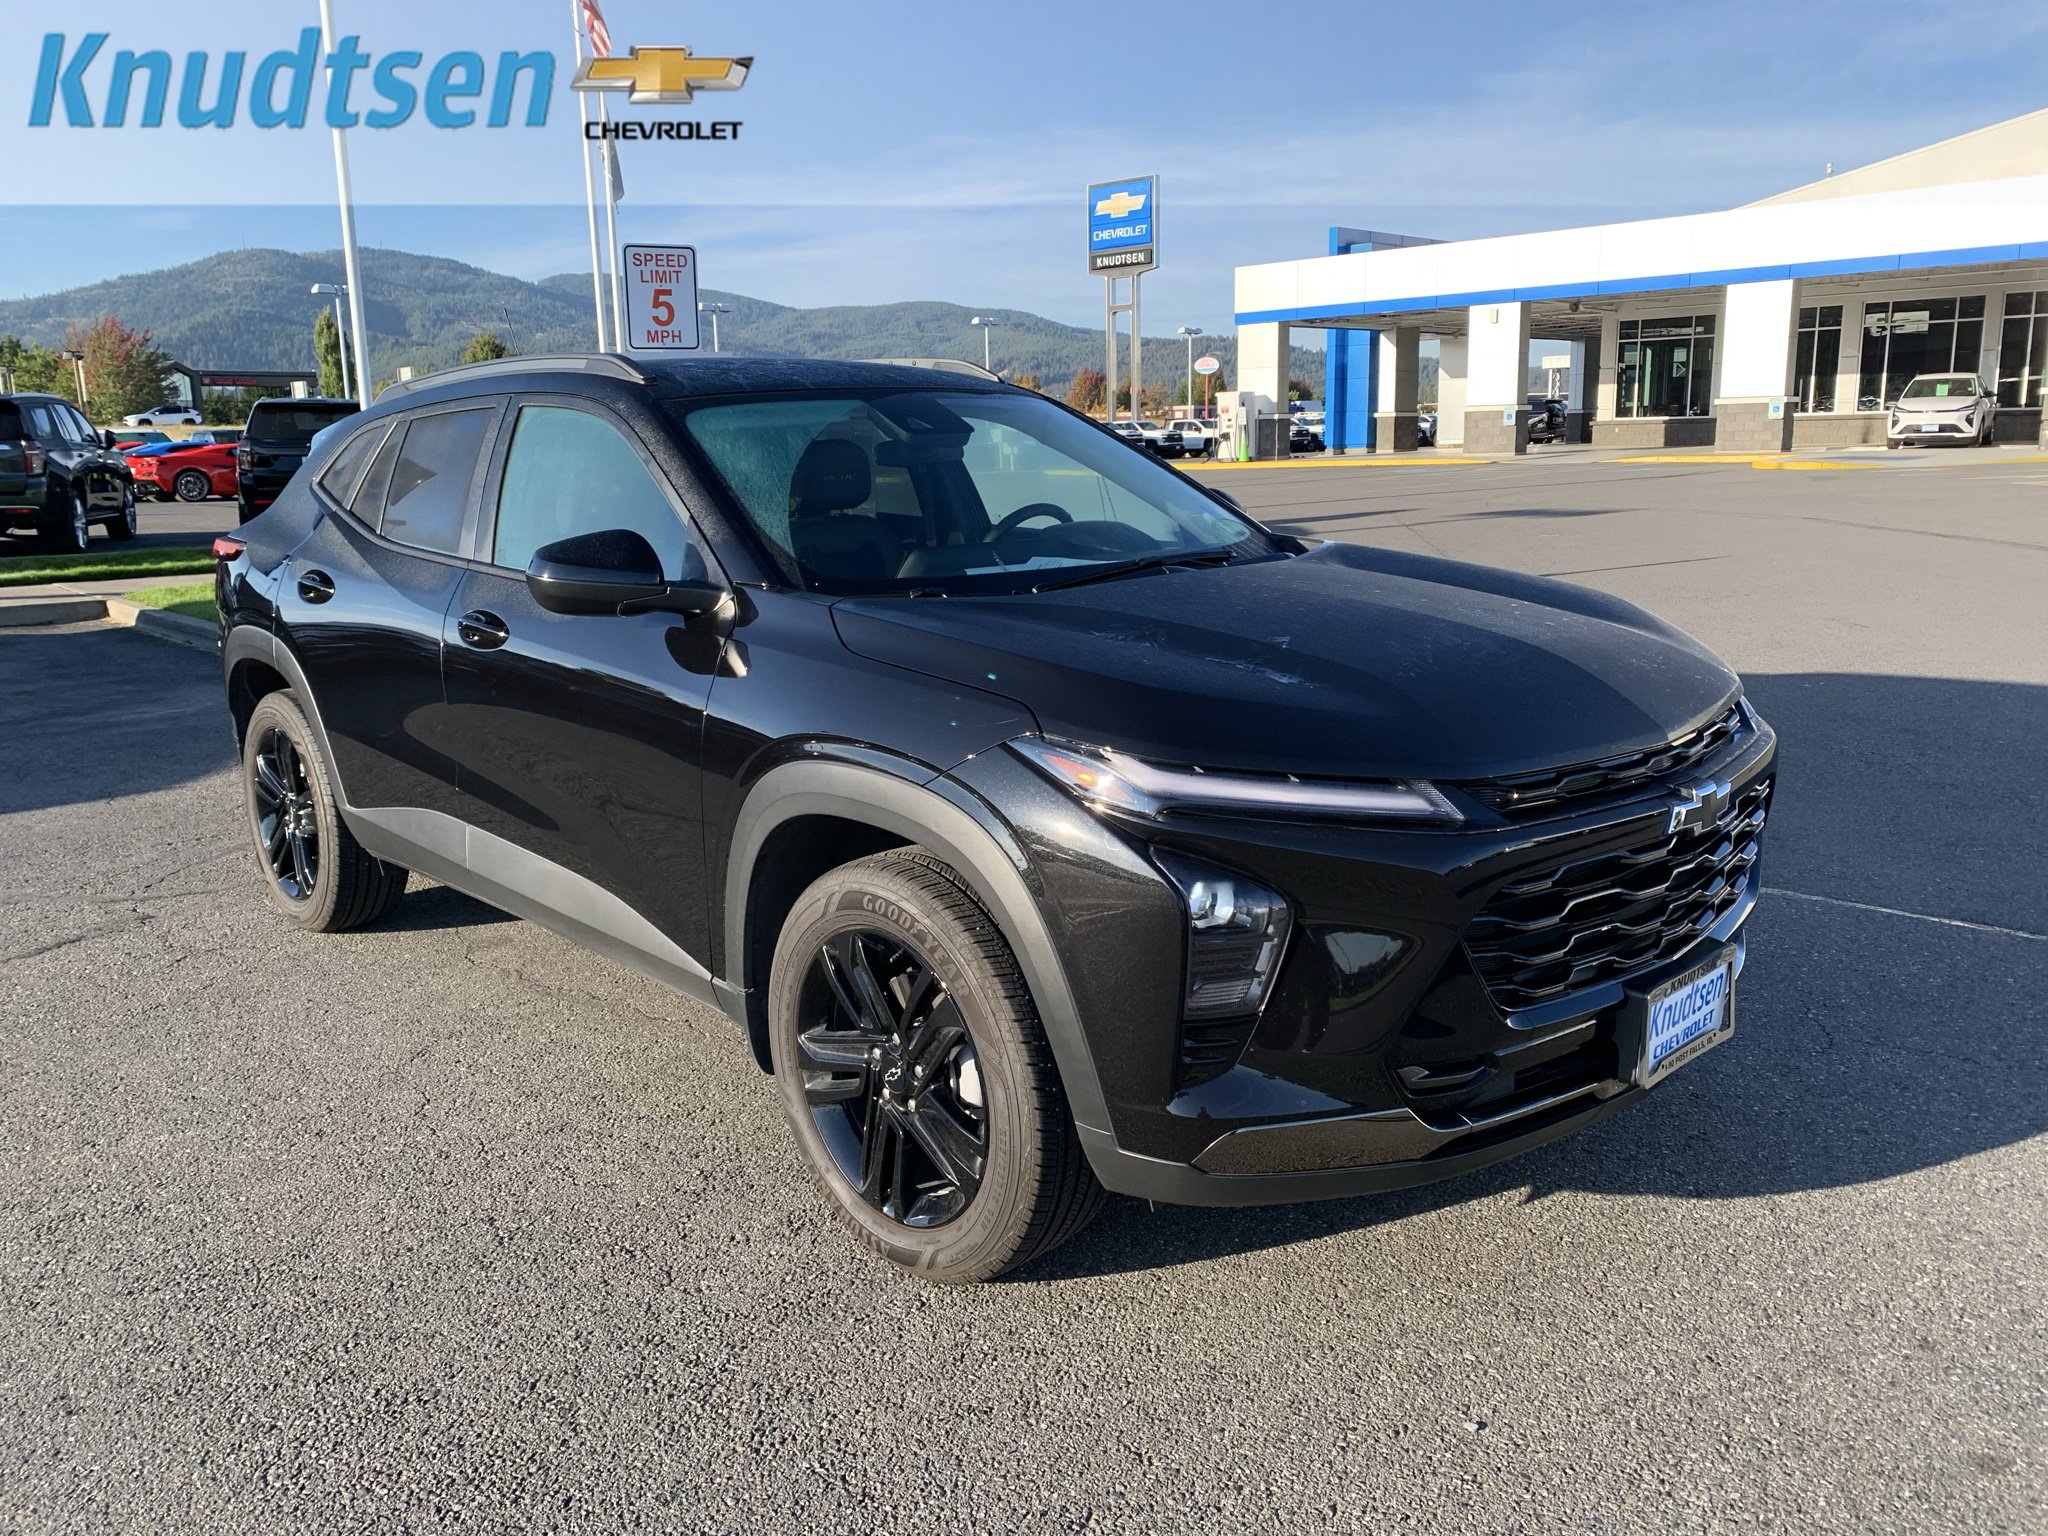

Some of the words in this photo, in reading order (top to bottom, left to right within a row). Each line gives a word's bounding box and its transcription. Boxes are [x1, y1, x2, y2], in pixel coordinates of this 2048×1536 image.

[1093, 224, 1147, 241] CHEVROLET
[632, 252, 688, 268] SPEED
[1096, 252, 1145, 267] KNUDTSEN
[640, 270, 682, 284] LIMIT
[651, 288, 675, 327] 5
[646, 329, 682, 344] MPH
[862, 894, 970, 997] GOODYEAR
[1669, 956, 1719, 992] KNUDTSEN
[1650, 972, 1724, 1041] Knudtsen
[1653, 1008, 1715, 1060] CHEVROLET
[1675, 1050, 1689, 1065] POST
